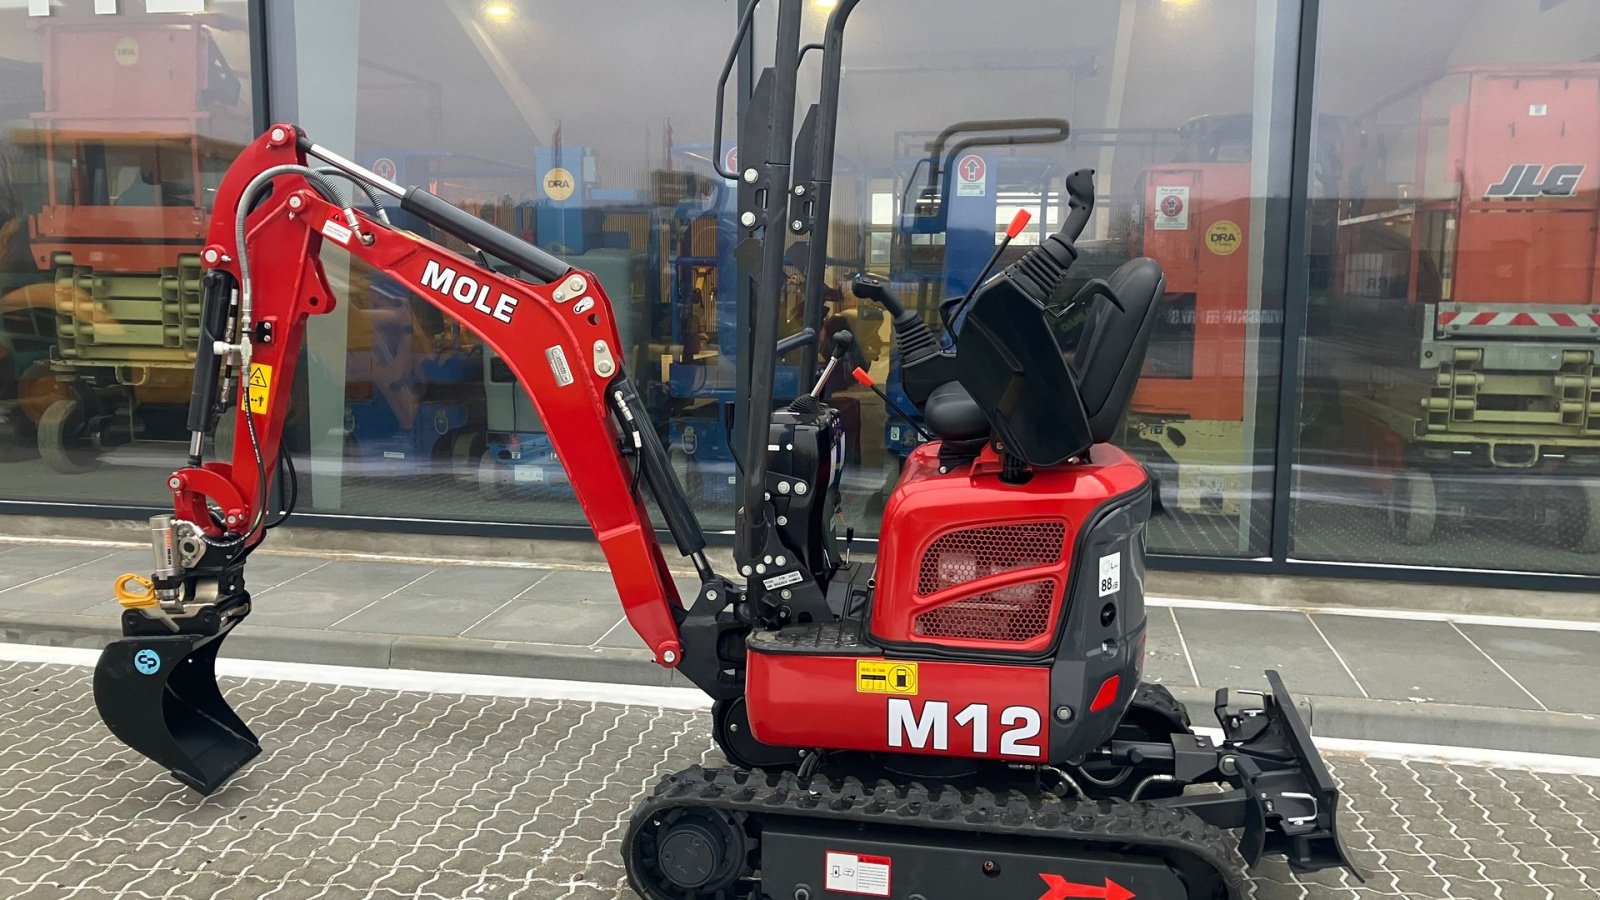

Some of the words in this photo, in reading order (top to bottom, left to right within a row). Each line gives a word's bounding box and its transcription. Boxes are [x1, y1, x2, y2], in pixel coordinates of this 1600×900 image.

[547, 179, 570, 189] DRA
[1483, 164, 1587, 197] JLG
[1210, 232, 1237, 243] DRA
[420, 259, 519, 324] MOLE
[887, 698, 1041, 758] M12
